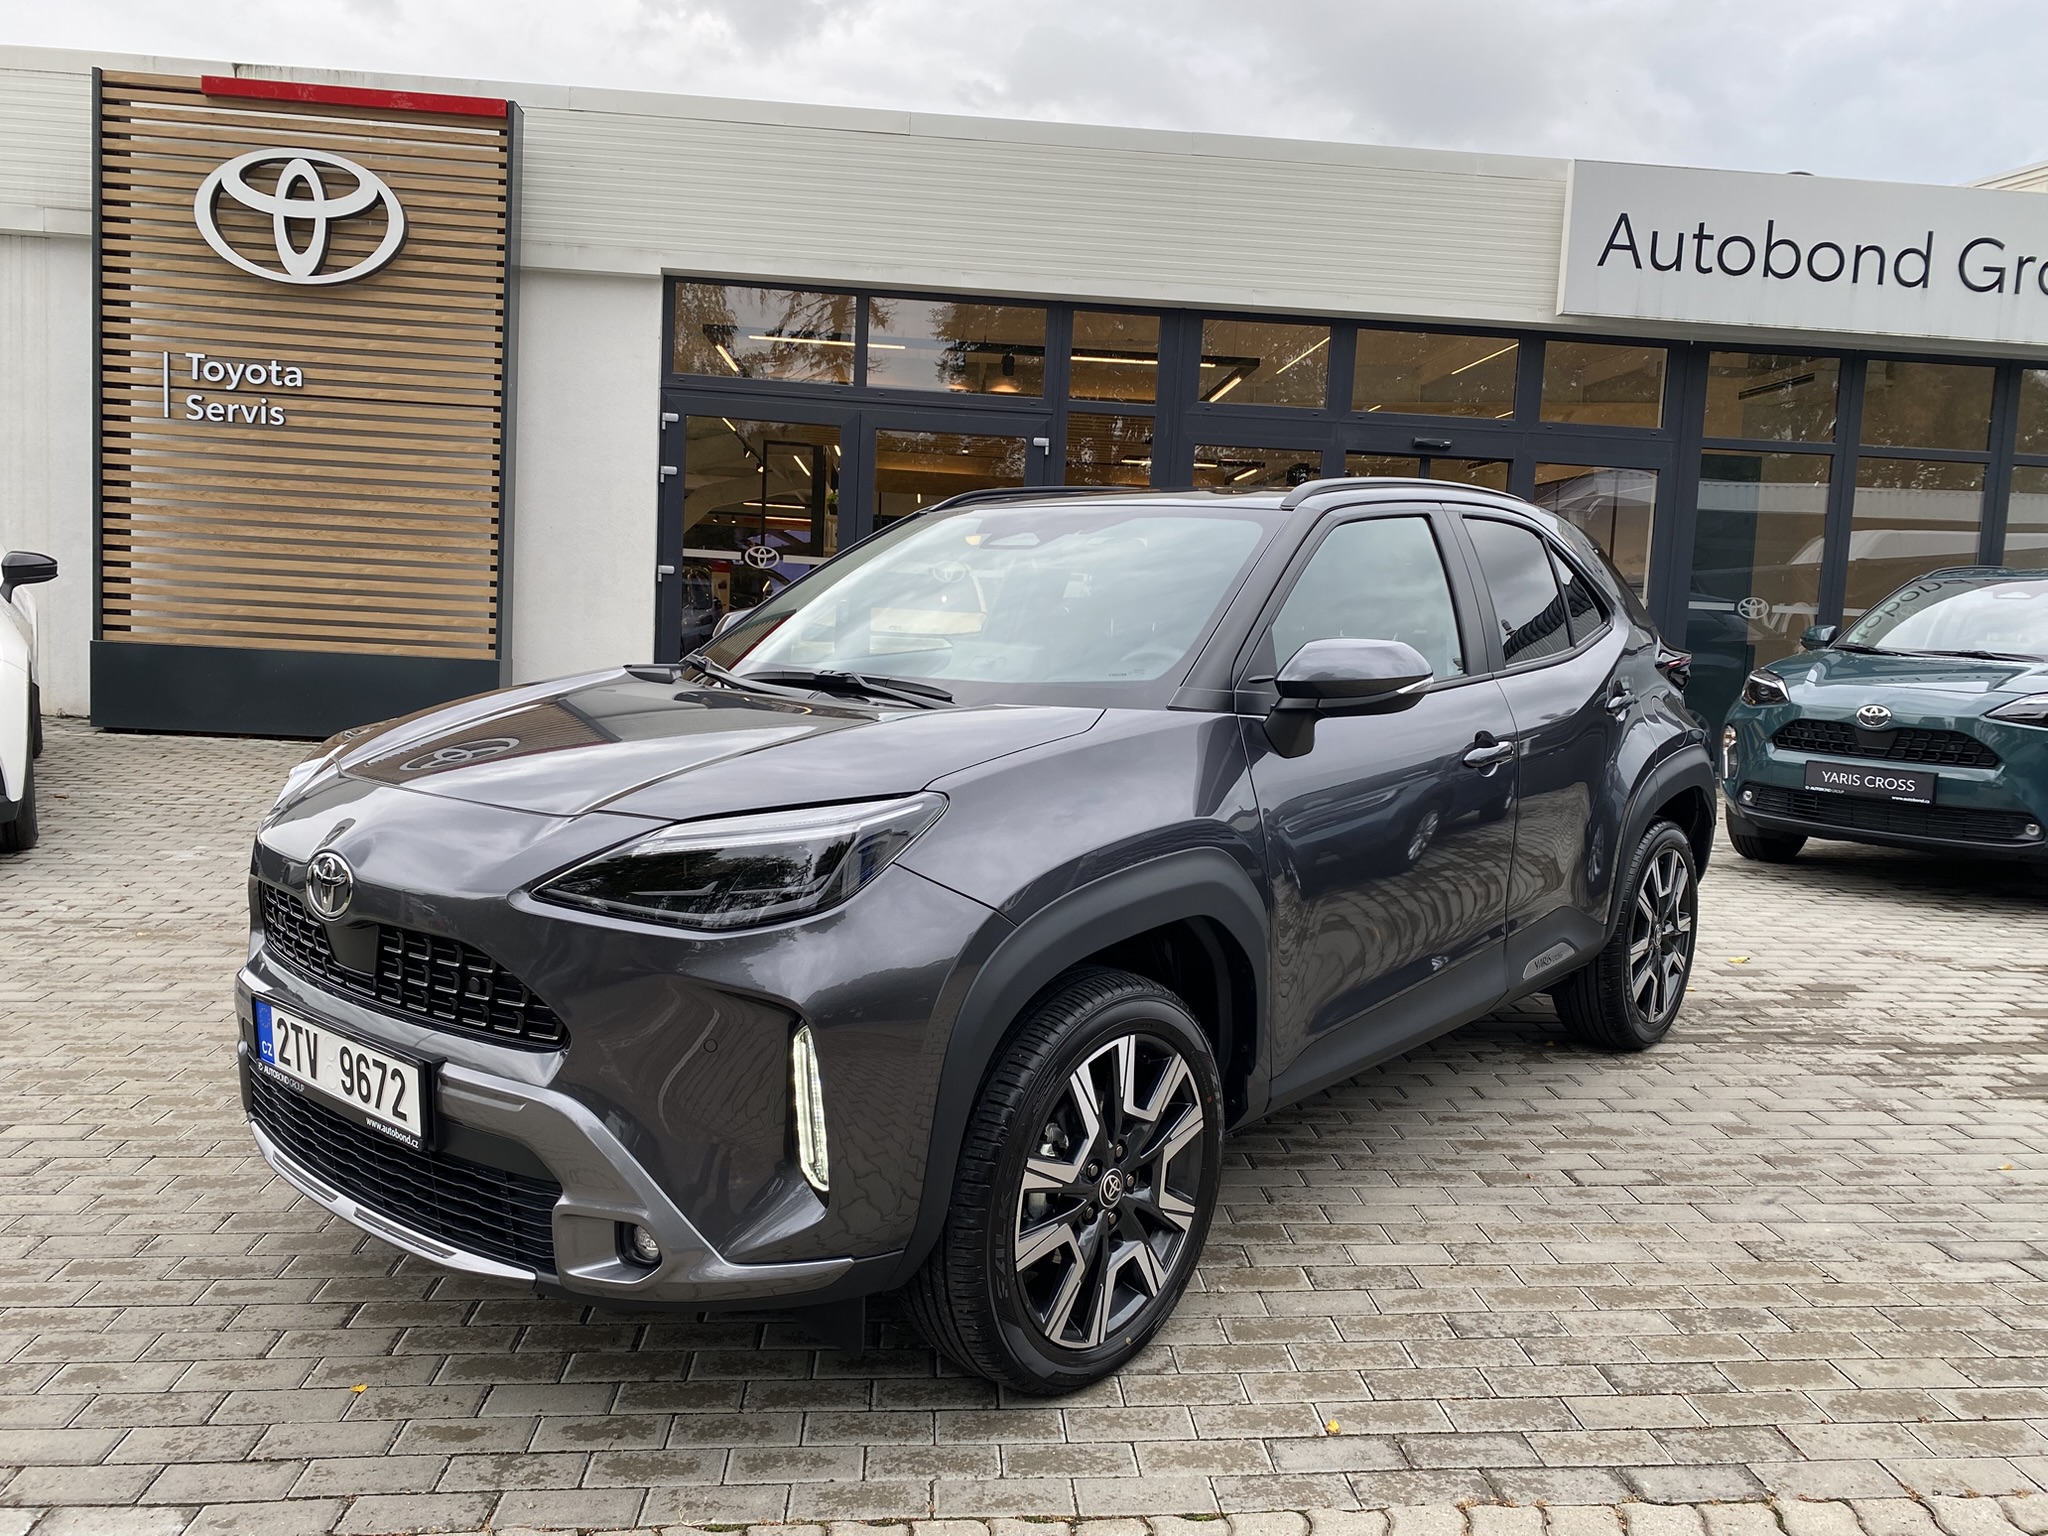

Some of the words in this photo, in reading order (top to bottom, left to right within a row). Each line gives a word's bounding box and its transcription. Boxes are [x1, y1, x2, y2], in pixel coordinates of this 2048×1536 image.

[1597, 212, 1934, 290] Autobond
[1958, 236, 2048, 297] Gr
[185, 352, 304, 391] Toyota
[185, 394, 286, 426] Servis
[1822, 770, 1861, 787] YARIS
[1864, 775, 1916, 793] CROSS
[261, 1040, 273, 1057] CZ
[263, 1064, 290, 1086] AUTOBOND
[276, 1017, 318, 1080] 2TV
[339, 1045, 408, 1122] 9672
[365, 1117, 419, 1149] www.autobond.cz
